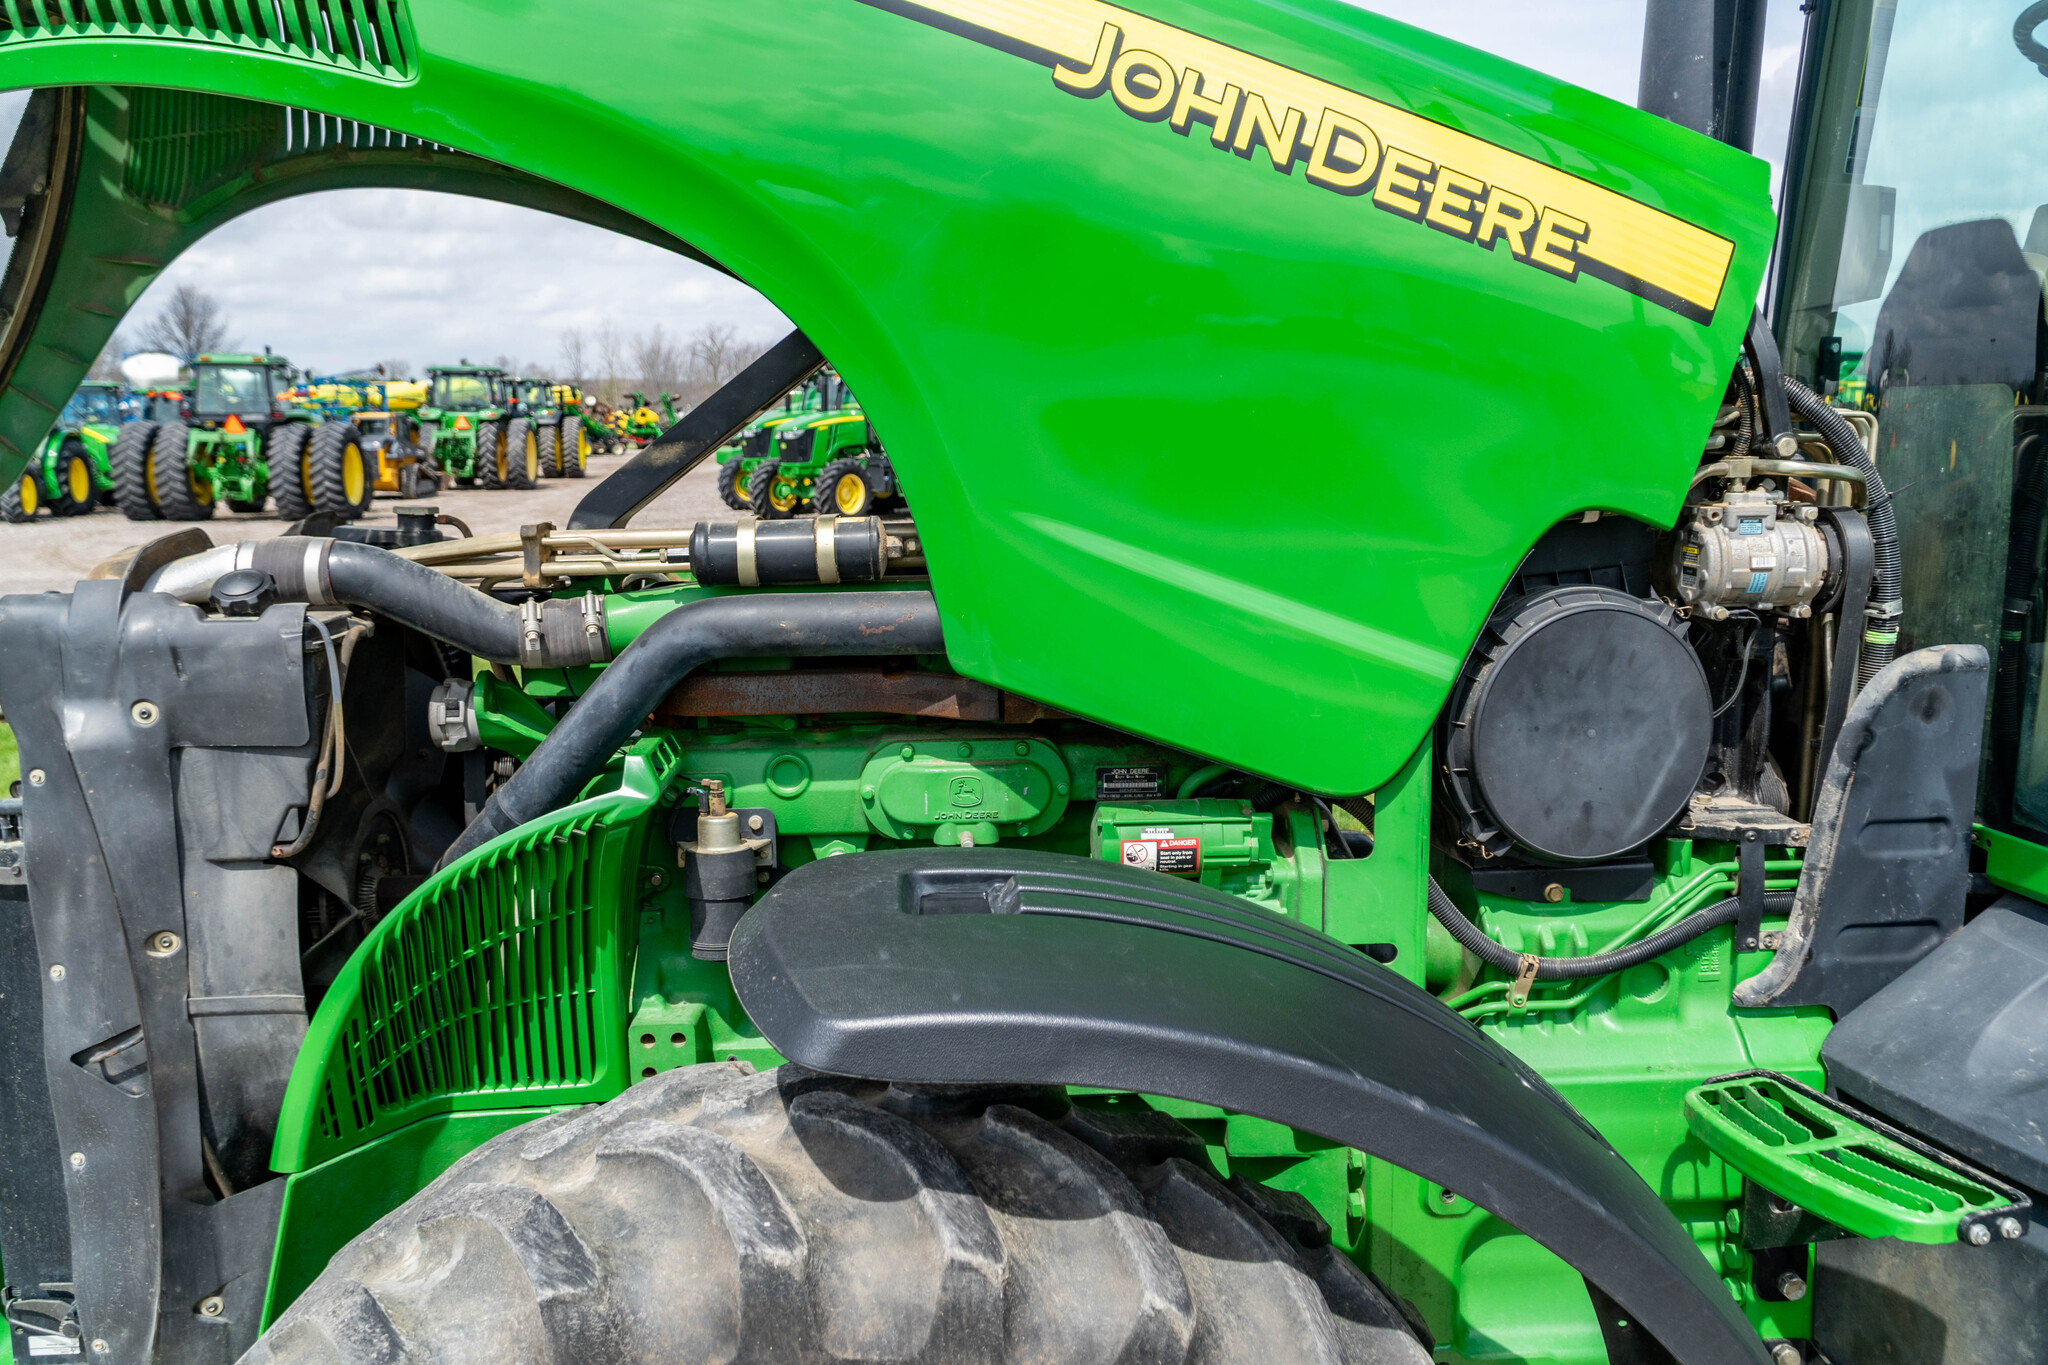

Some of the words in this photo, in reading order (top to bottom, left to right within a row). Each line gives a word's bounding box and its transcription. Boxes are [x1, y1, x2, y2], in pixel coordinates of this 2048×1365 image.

[1052, 21, 1305, 176] JOHN
[1304, 106, 1591, 283] DEERE
[934, 811, 962, 820] JOHN
[965, 810, 999, 820] DEERE
